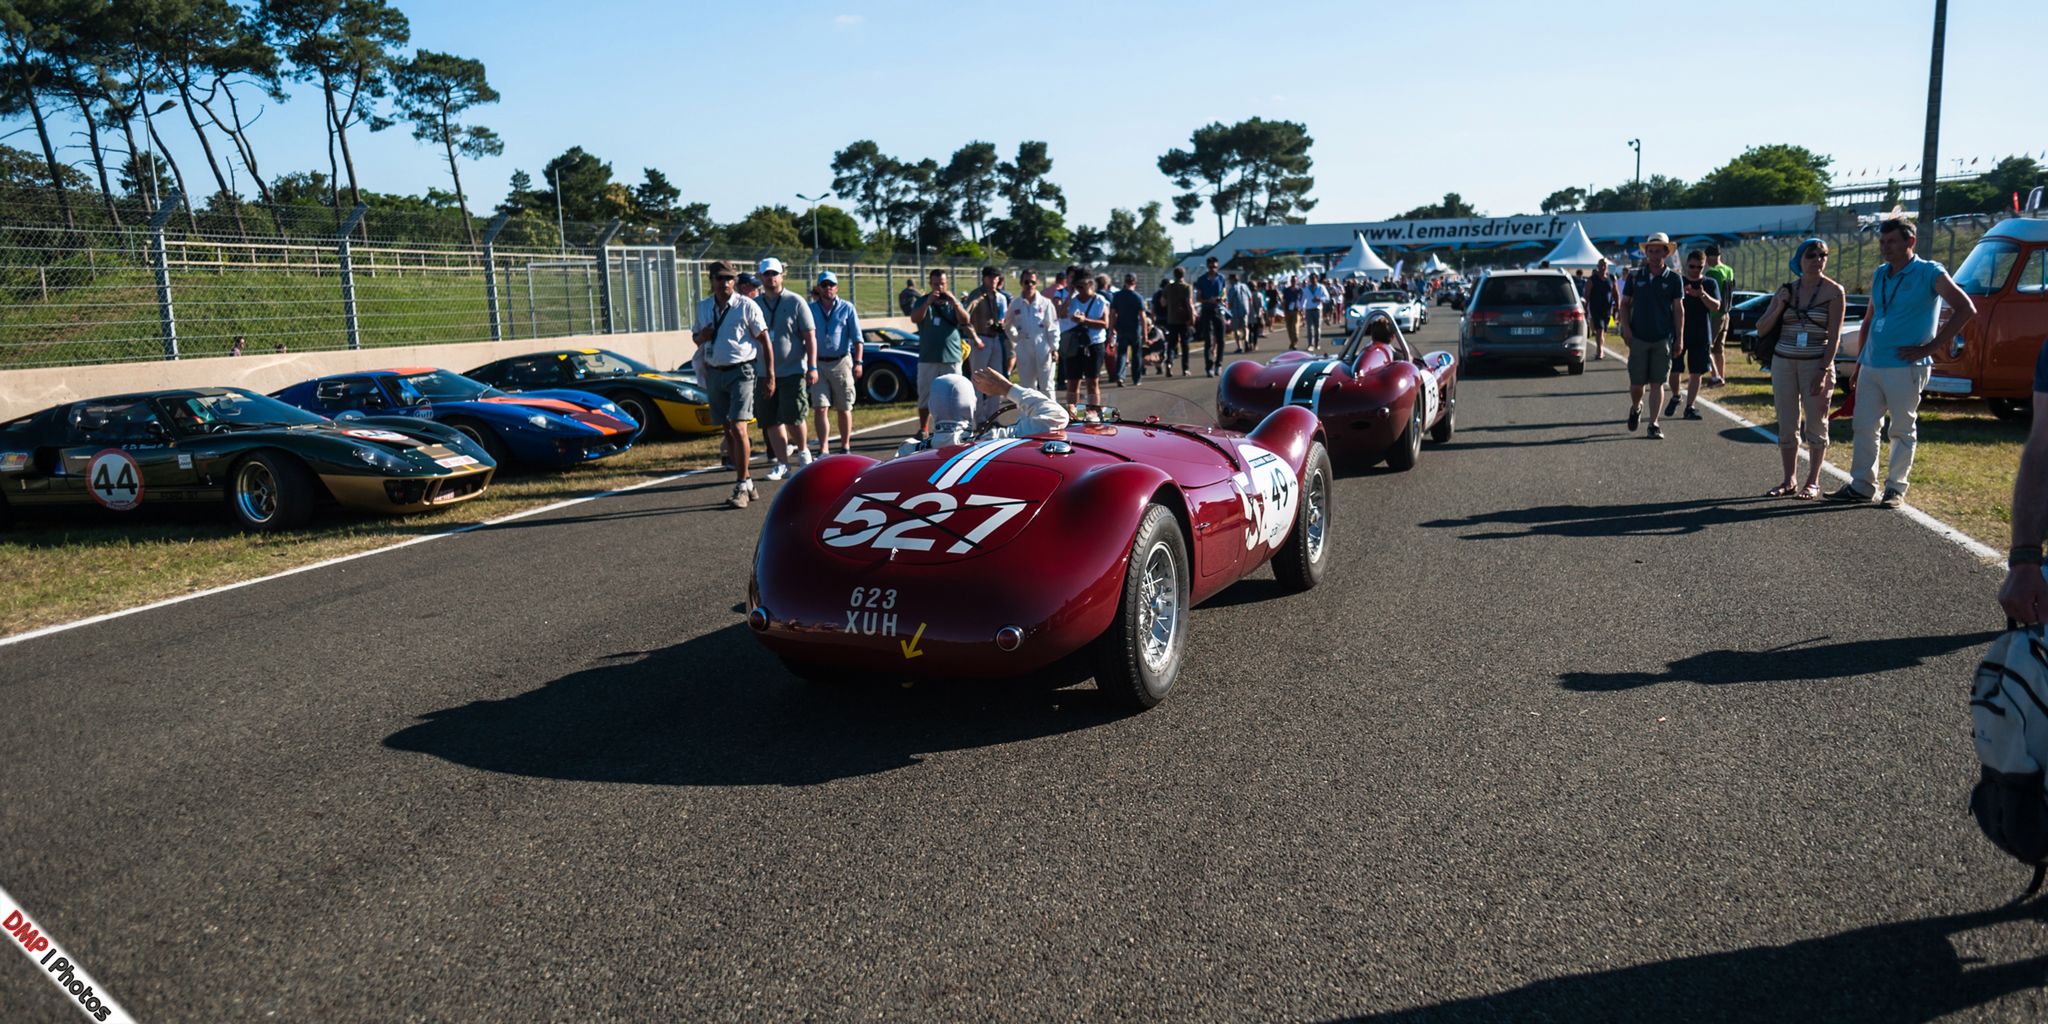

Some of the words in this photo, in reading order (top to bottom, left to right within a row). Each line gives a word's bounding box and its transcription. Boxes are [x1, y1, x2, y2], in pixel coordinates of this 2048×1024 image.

[1353, 217, 1567, 240] www.lemansdriver.fr
[93, 463, 138, 496] 44
[1270, 467, 1289, 511] 49
[821, 491, 1028, 554] 527
[850, 586, 897, 610] 623
[844, 610, 898, 637] XUH
